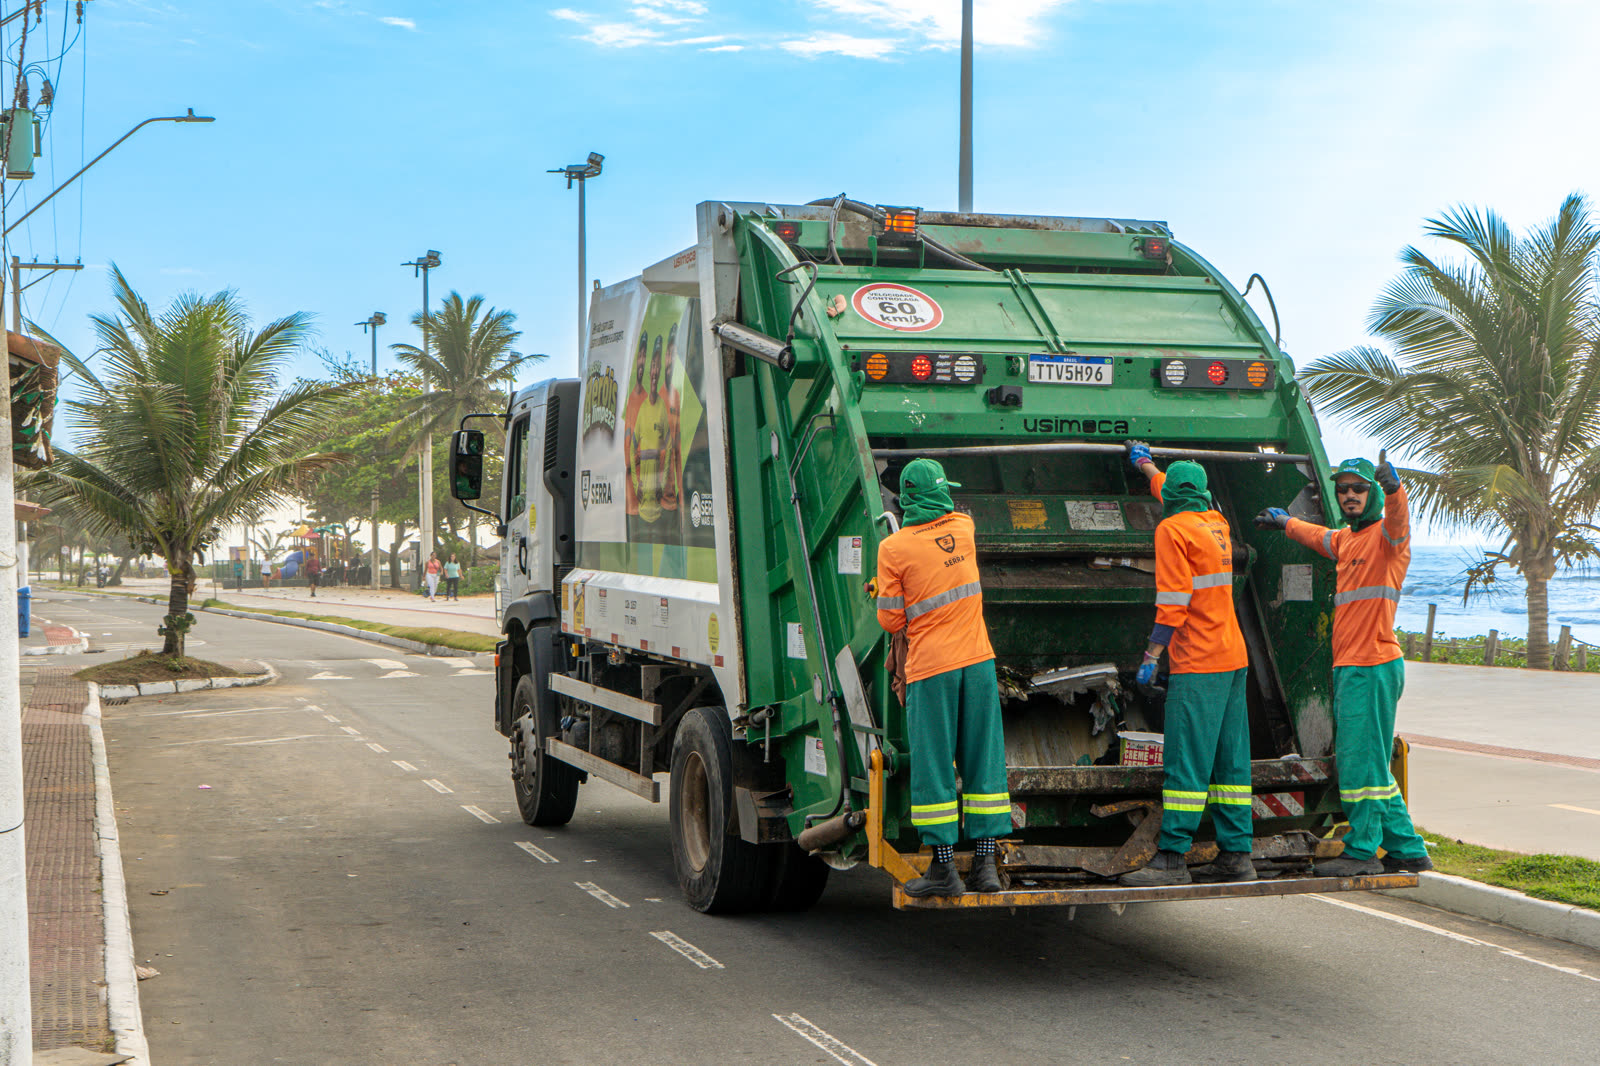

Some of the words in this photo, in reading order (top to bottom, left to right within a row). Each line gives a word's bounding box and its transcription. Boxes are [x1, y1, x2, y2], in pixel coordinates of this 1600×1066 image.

[878, 301, 917, 315] 60
[880, 314, 926, 324] km/h
[1036, 363, 1103, 382] TTV5H96
[591, 482, 612, 505] SERRA
[944, 555, 965, 568] SERRA
[1125, 750, 1149, 761] CREME
